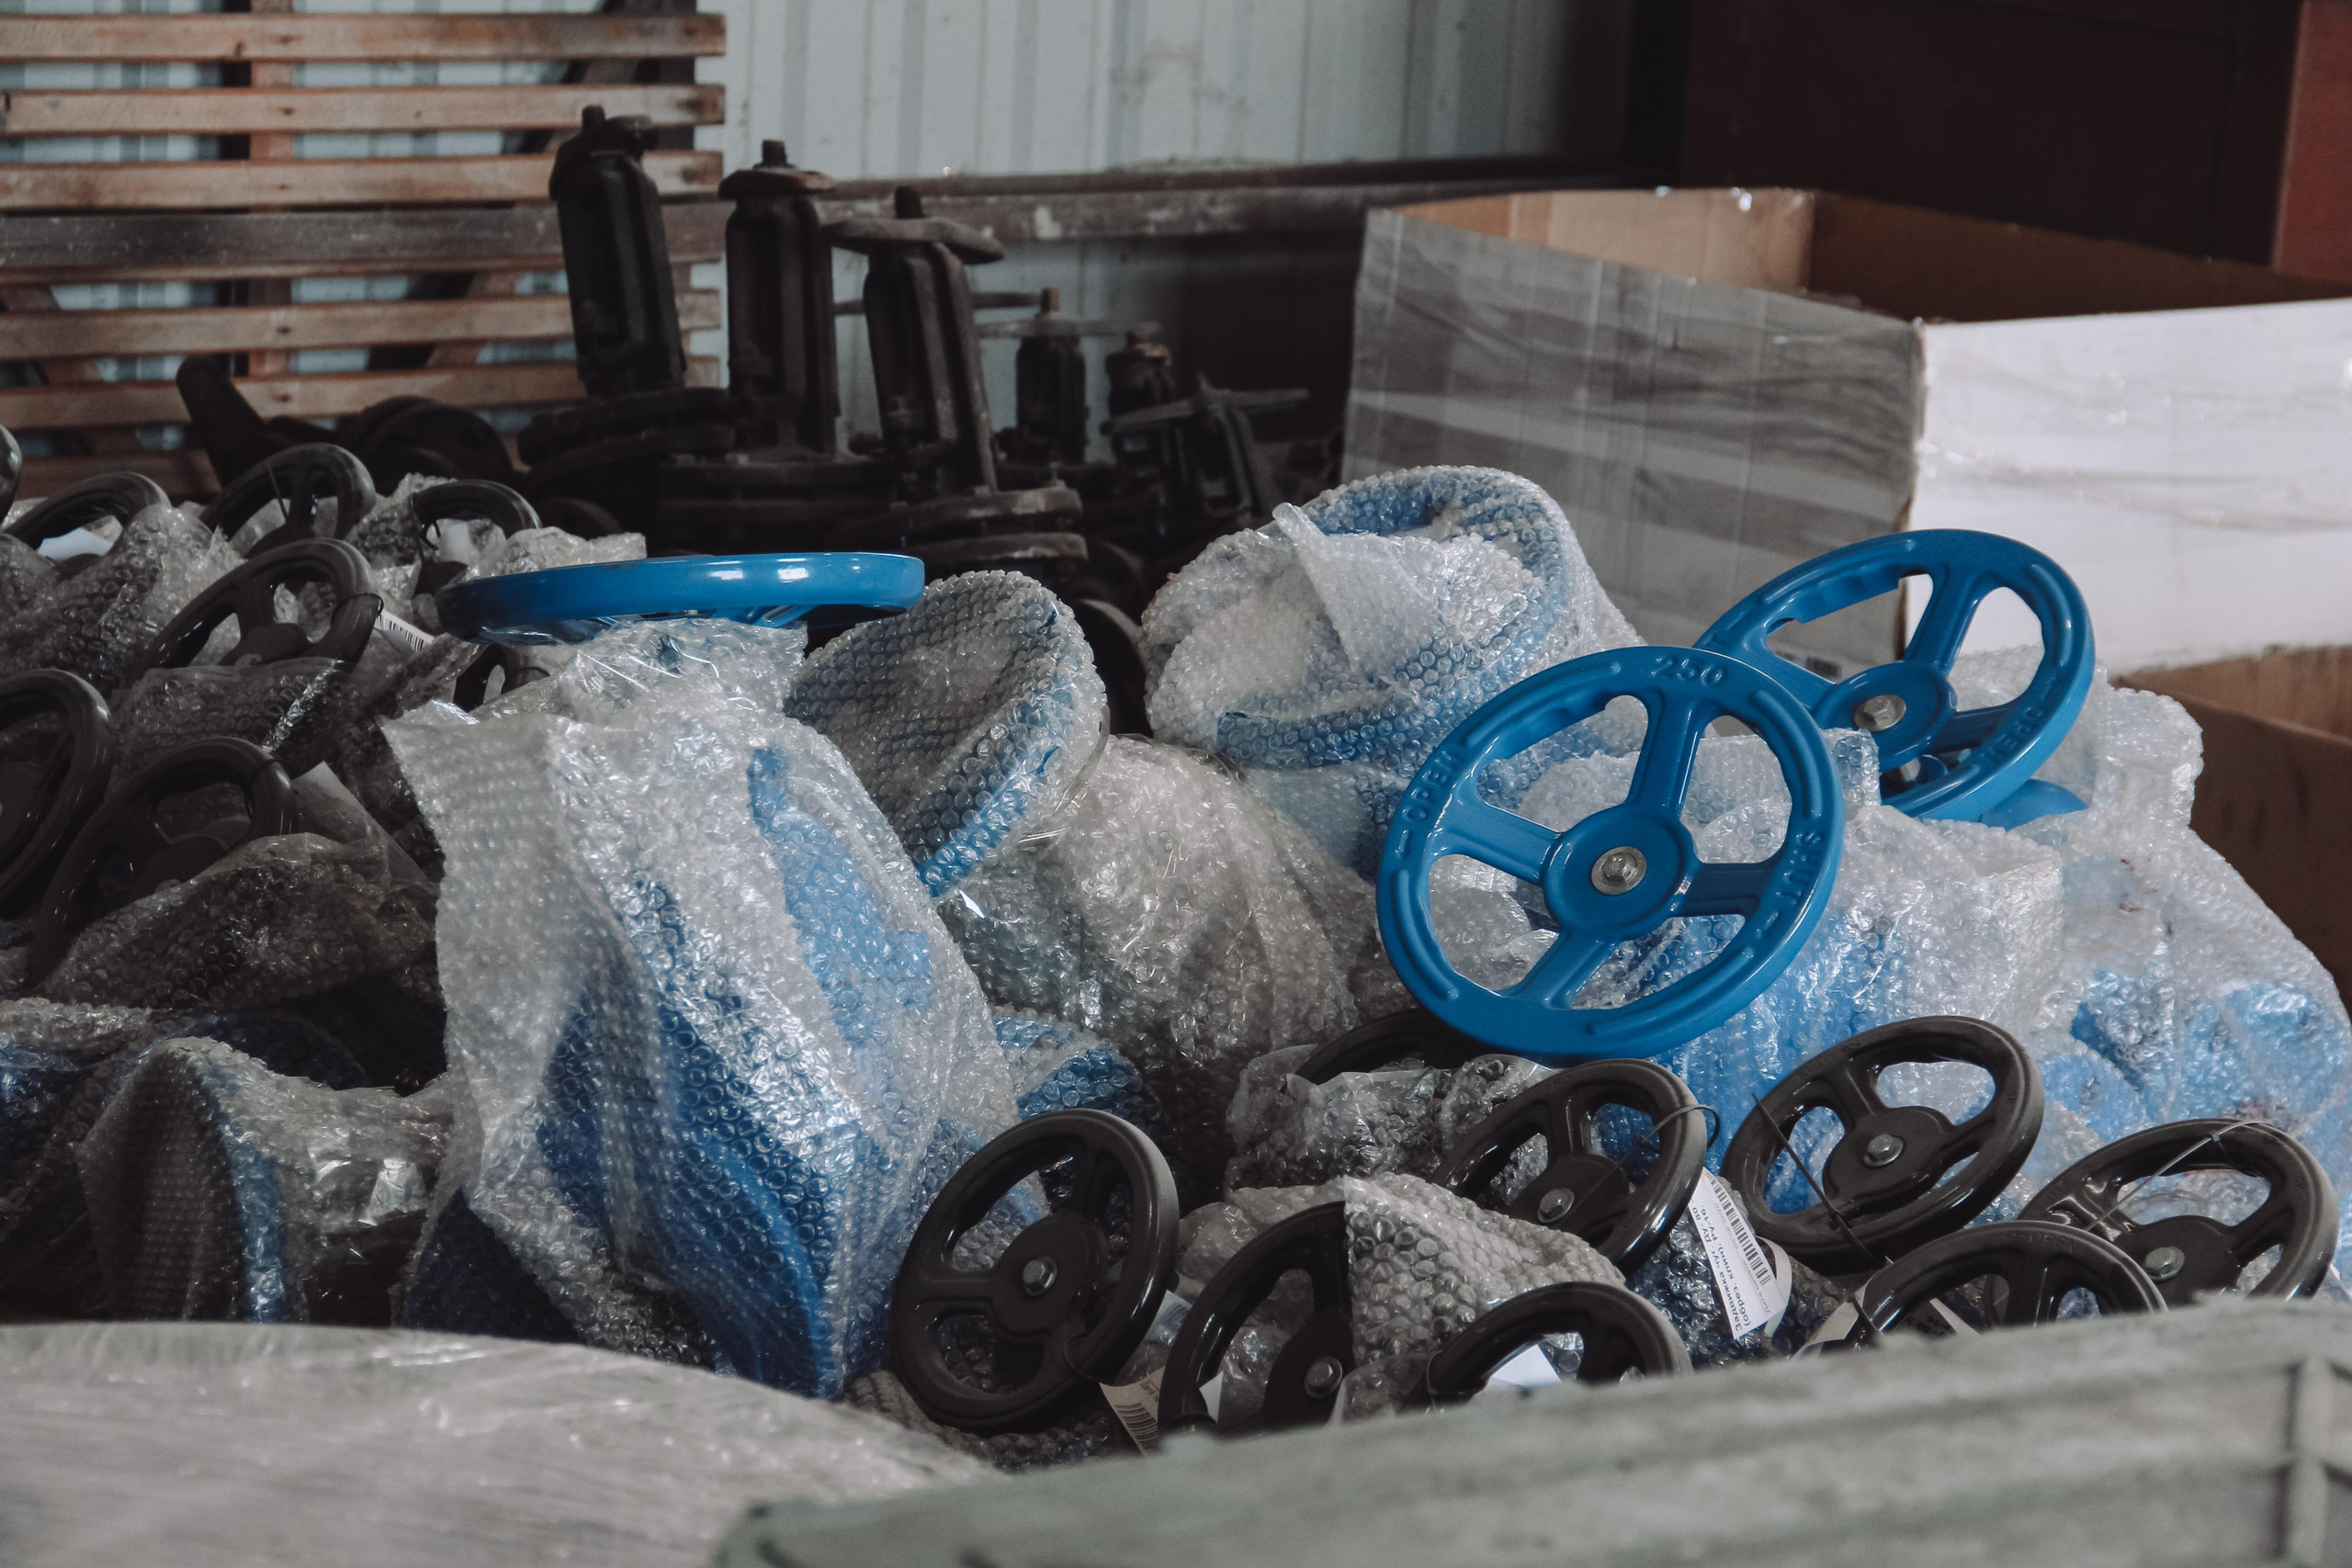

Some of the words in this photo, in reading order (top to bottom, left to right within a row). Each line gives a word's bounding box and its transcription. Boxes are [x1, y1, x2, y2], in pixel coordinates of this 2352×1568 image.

[1650, 654, 1727, 687] 250
[1978, 701, 2048, 764] OPEN
[1403, 746, 1464, 825] OPEN
[1779, 829, 1824, 907] SHUT
[1691, 1206, 1702, 1221] 80
[1700, 1204, 1719, 1241] Ру-16.
[1709, 1246, 1722, 1269] чуг.
[1716, 1242, 1735, 1280] клин),
[1717, 1271, 1743, 1332] Задвижка
[1730, 1282, 1753, 1326] (обрез.
